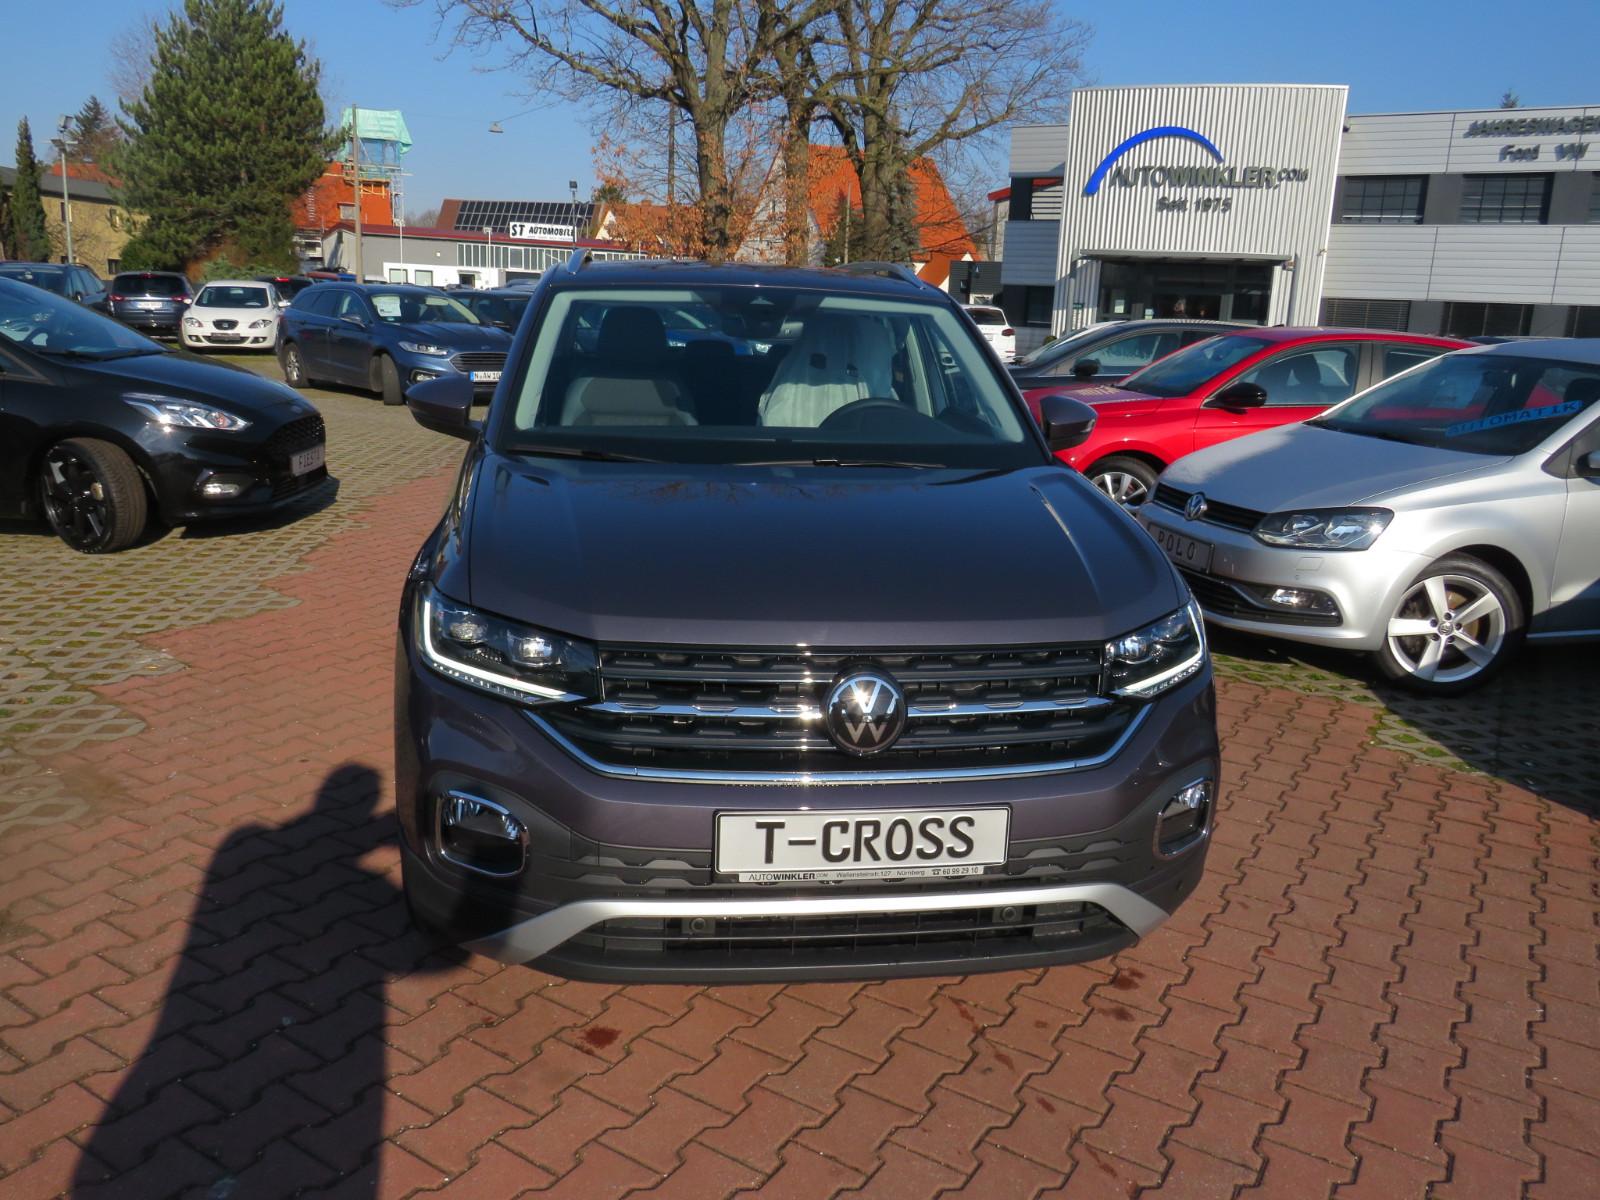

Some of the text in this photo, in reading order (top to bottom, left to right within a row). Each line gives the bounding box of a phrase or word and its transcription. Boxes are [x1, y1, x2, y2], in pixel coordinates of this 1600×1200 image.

[1498, 144, 1541, 162] Ford
[1156, 196, 1232, 213] Seit 1975
[511, 223, 526, 237] ST
[1447, 402, 1577, 435] AUTOMATIK
[1158, 530, 1196, 560] POLO
[755, 815, 977, 865] T-CROSS
